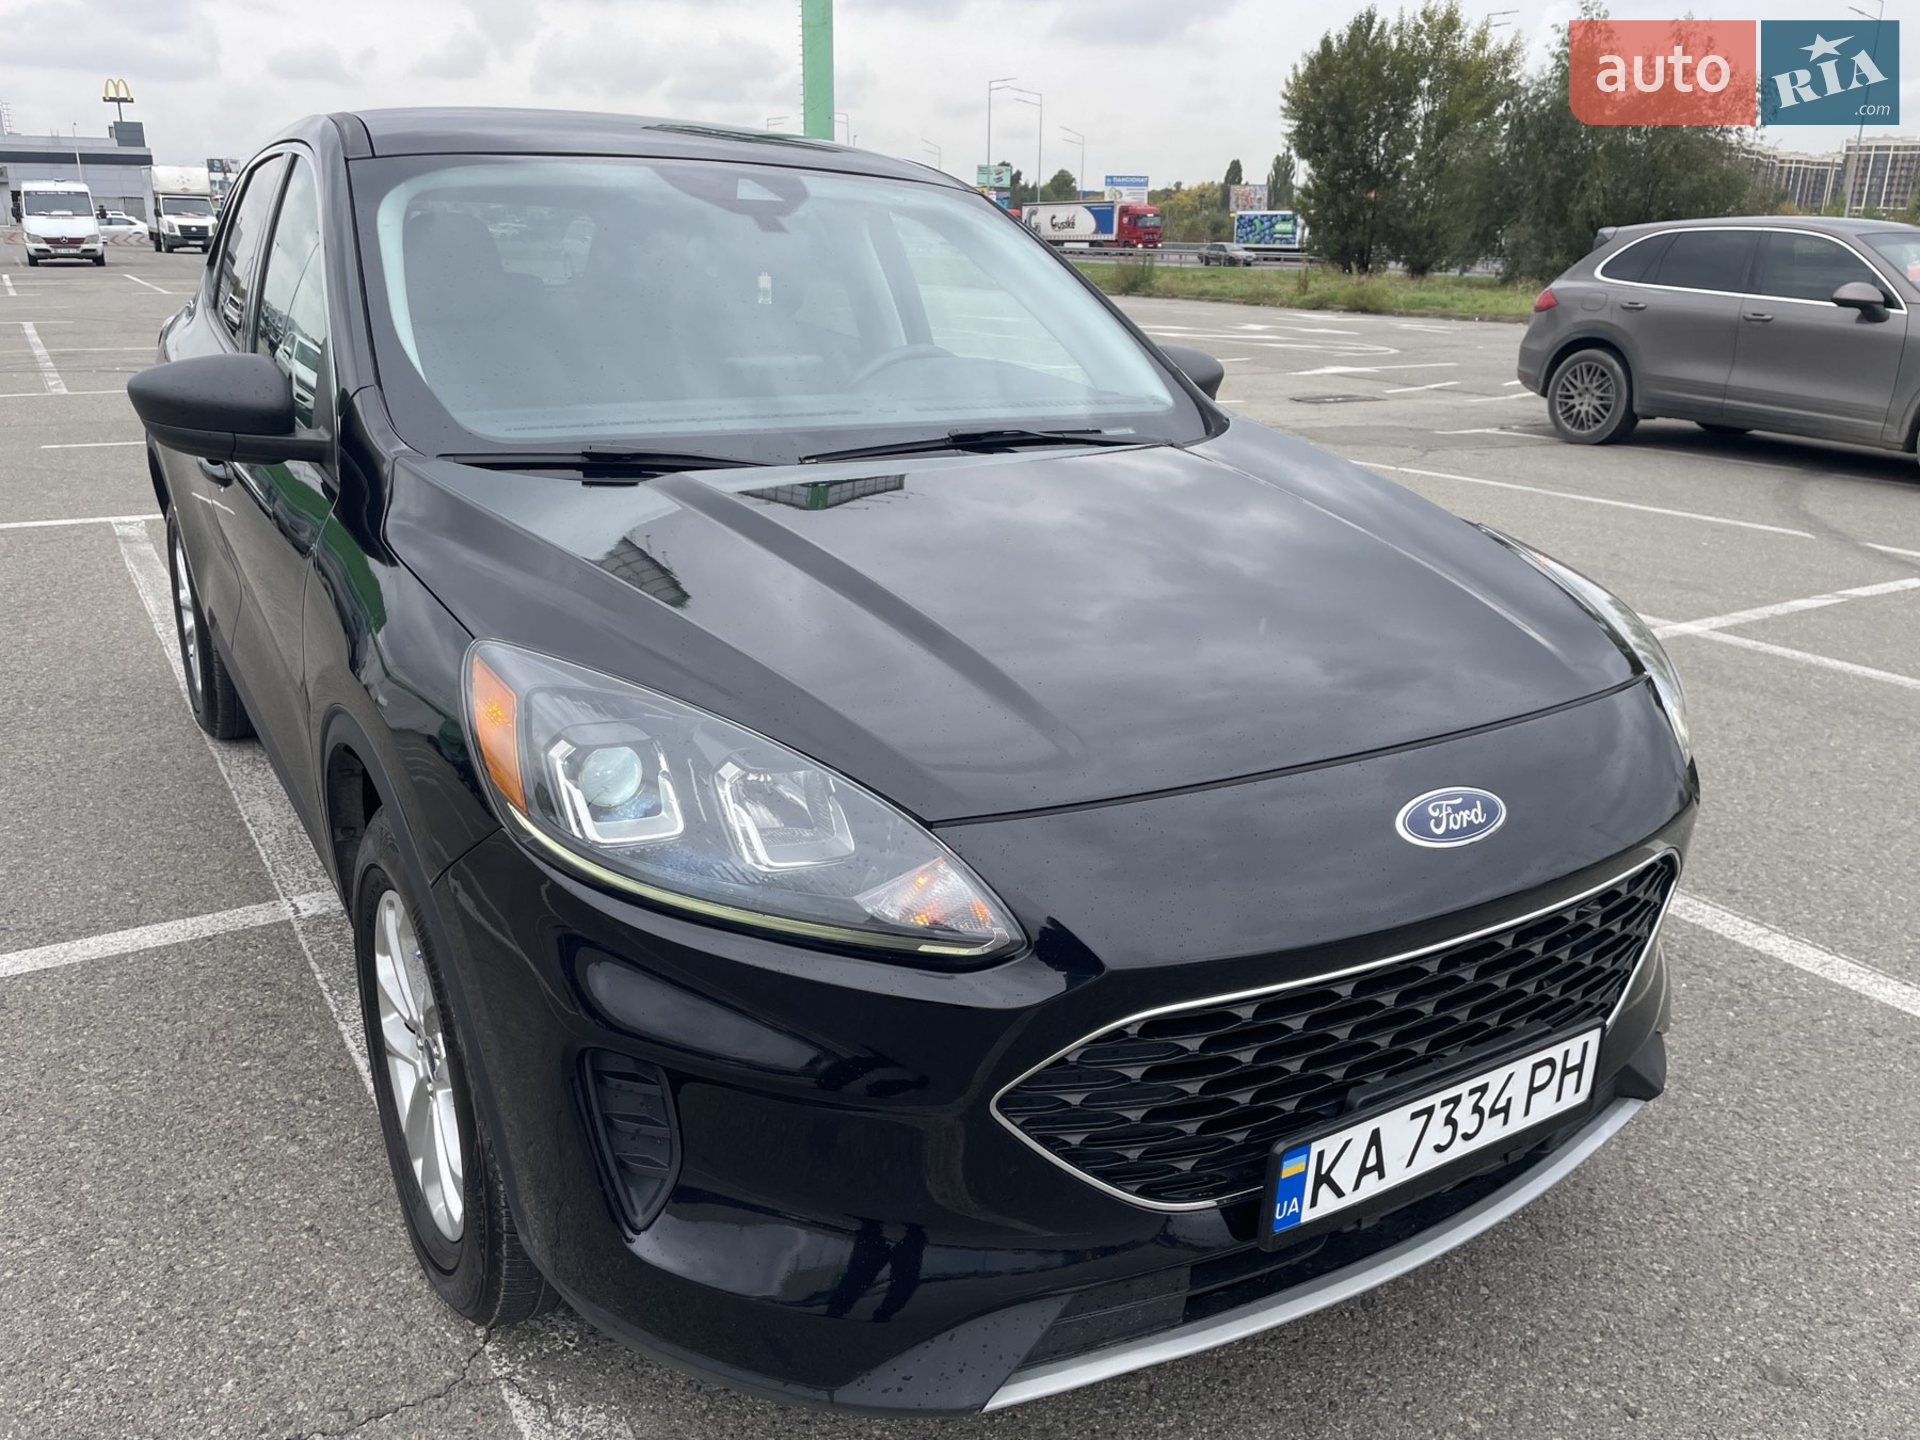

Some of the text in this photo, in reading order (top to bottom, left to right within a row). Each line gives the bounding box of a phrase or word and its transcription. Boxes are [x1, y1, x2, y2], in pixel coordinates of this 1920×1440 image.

[1427, 797, 1487, 835] Ford
[1405, 1072, 1516, 1169] 7334
[1275, 1196, 1300, 1220] UA
